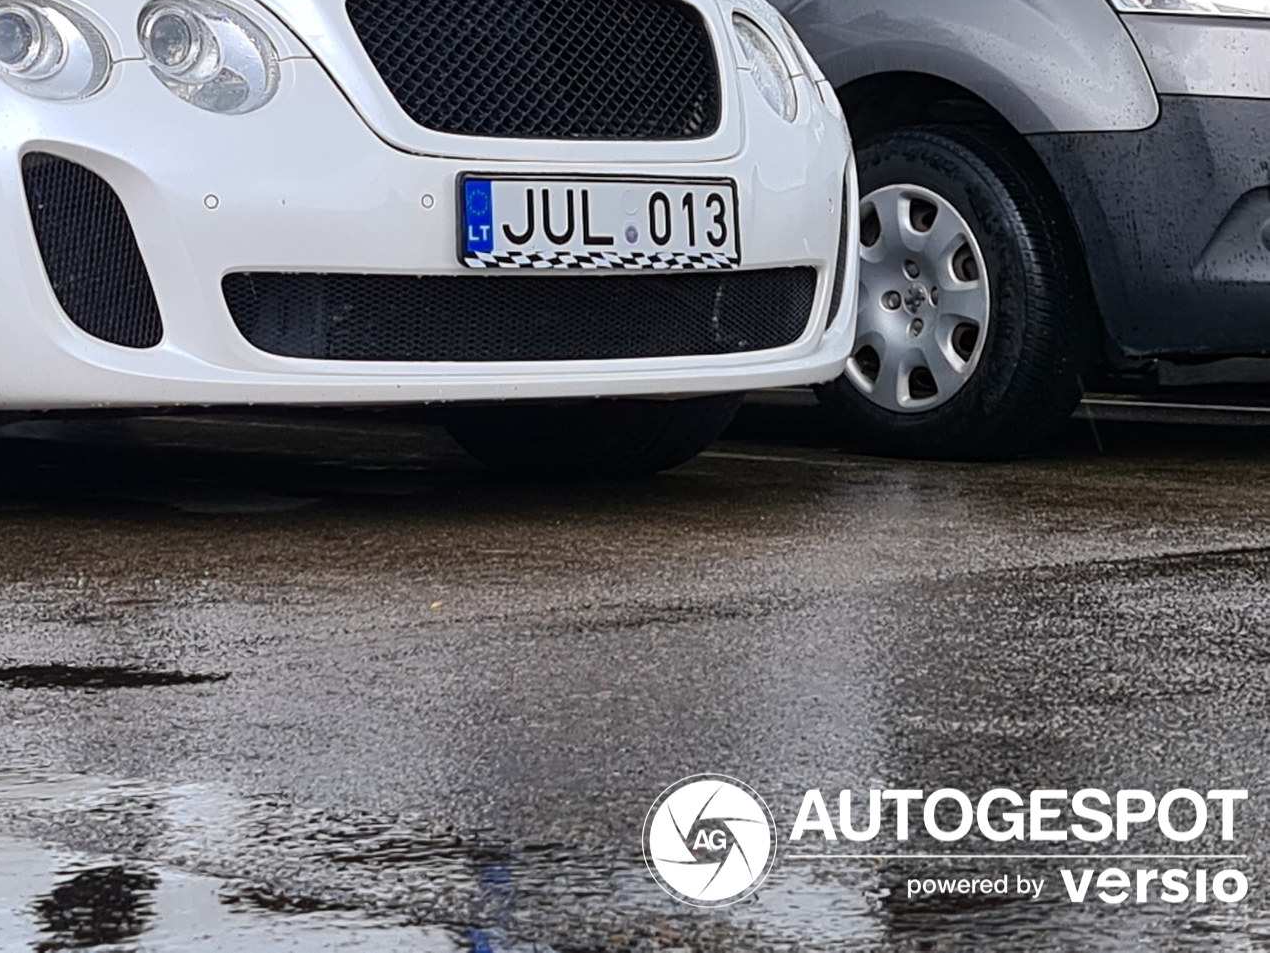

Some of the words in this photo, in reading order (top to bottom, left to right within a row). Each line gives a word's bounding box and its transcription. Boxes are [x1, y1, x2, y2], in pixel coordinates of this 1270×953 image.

[468, 224, 490, 242] LT
[501, 188, 615, 246] JUL
[648, 190, 728, 247] 013
